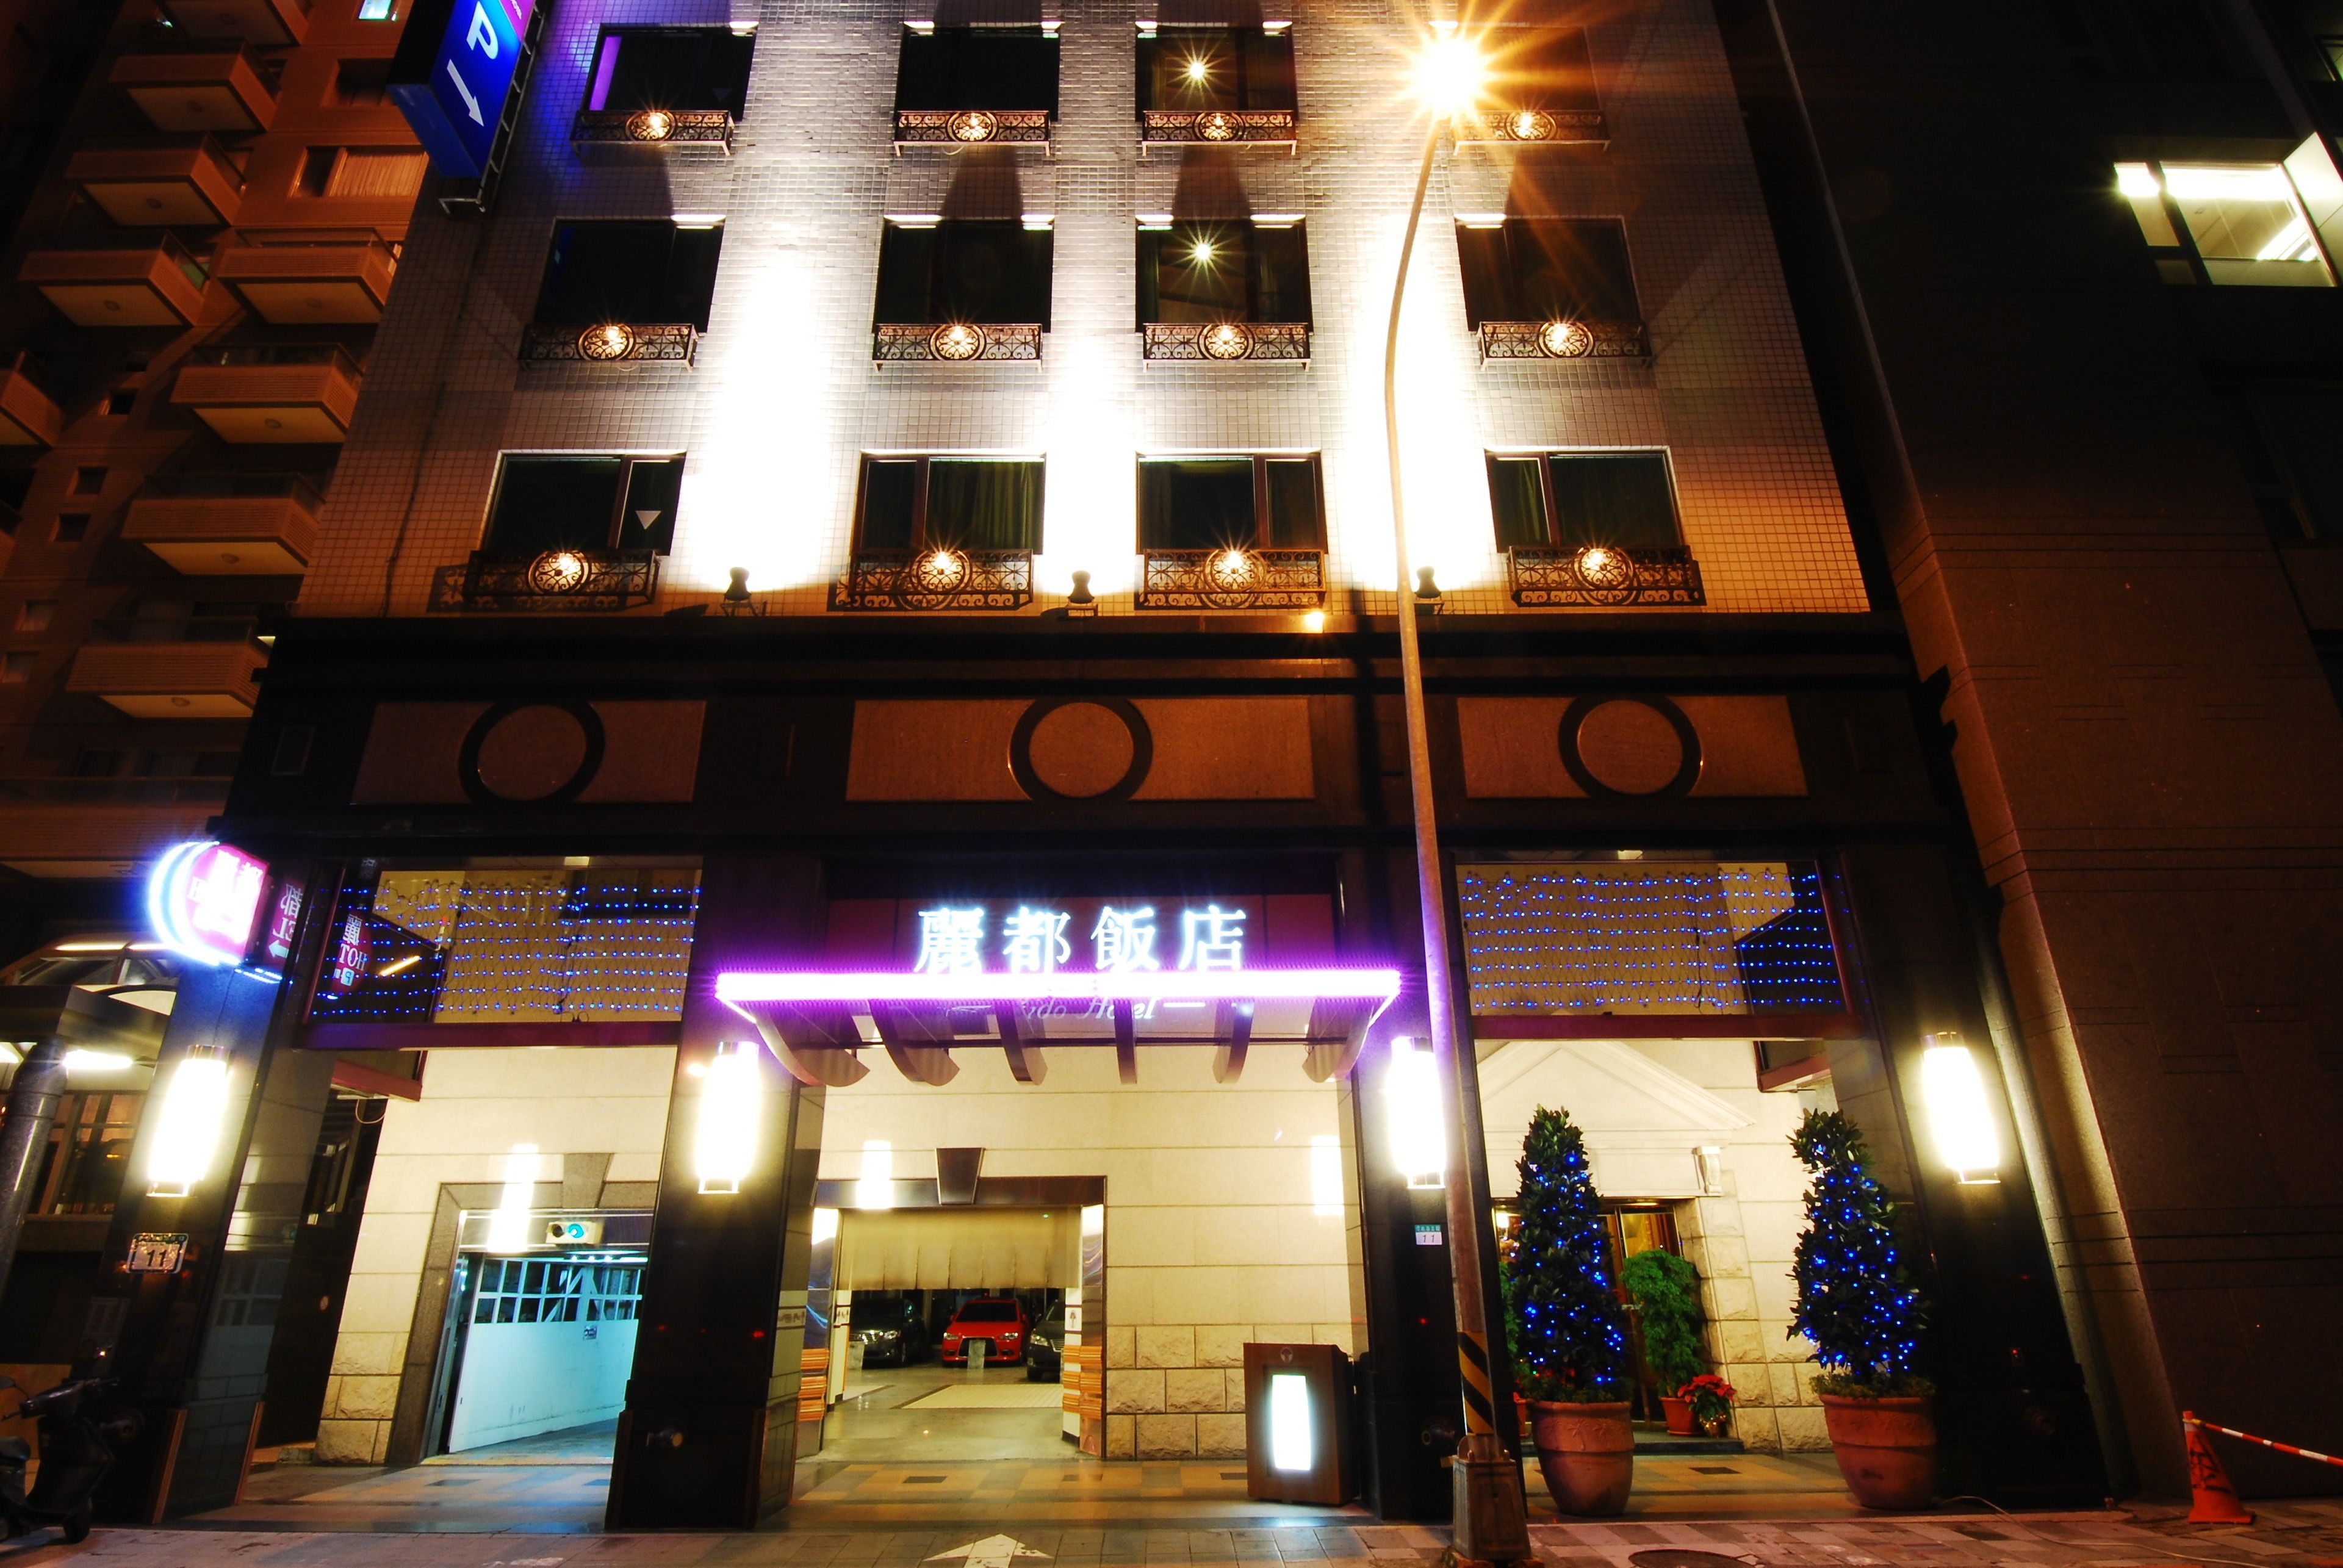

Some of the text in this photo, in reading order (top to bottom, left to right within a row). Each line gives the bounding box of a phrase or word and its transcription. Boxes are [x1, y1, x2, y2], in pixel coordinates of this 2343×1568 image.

[466, 0, 498, 59] P
[915, 905, 1246, 973] 麗都飯店
[1422, 1234, 1434, 1243] 11
[147, 1250, 167, 1267] 11
